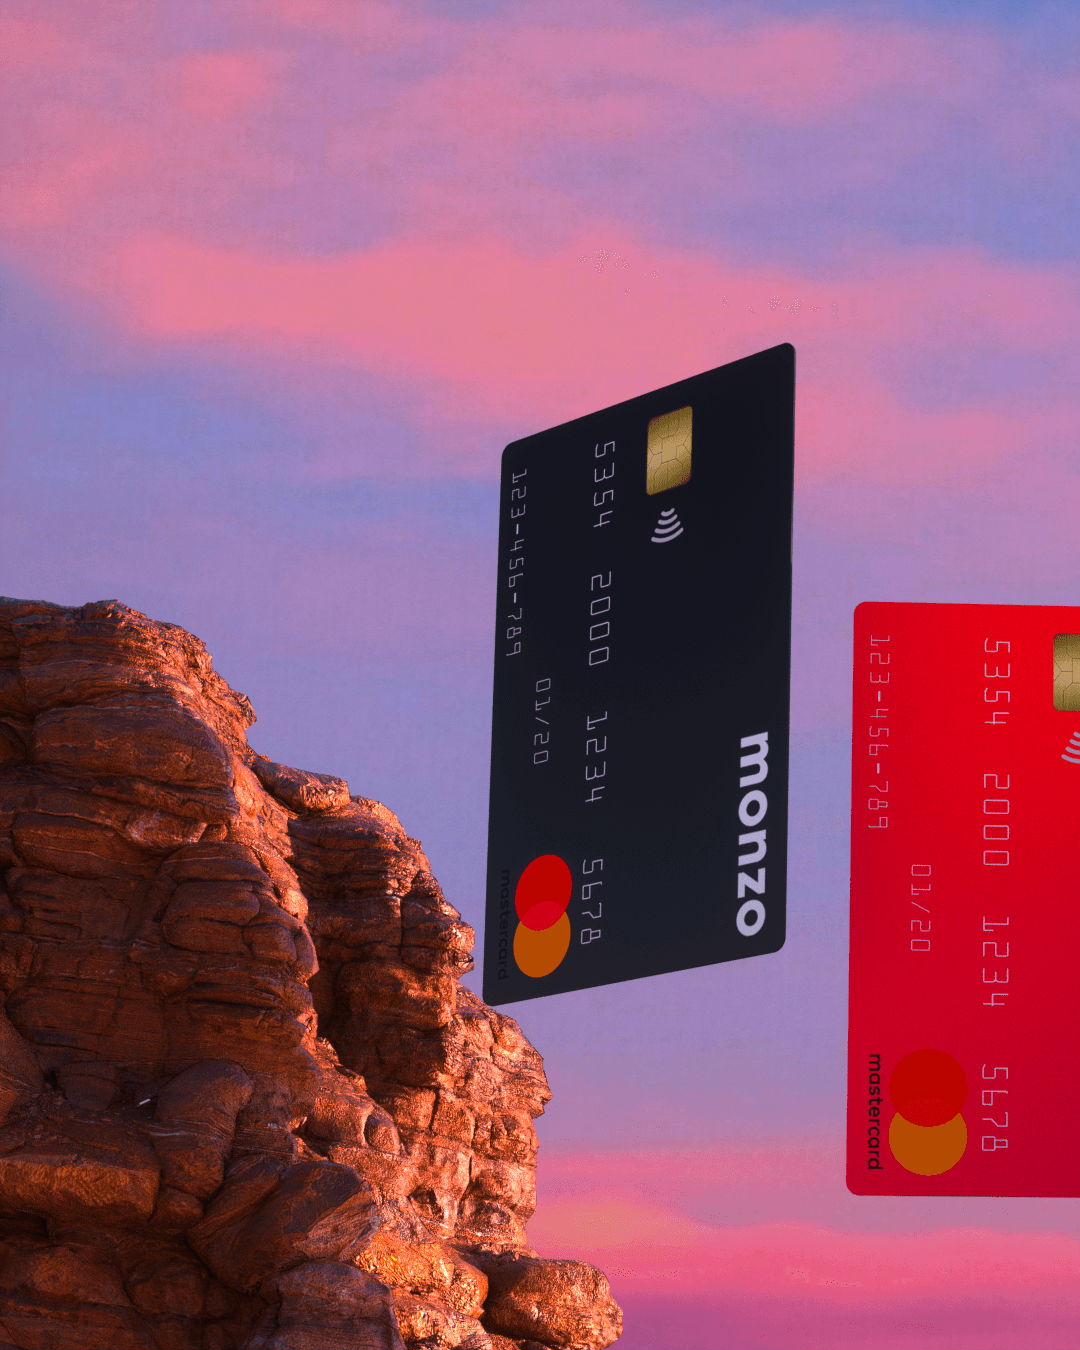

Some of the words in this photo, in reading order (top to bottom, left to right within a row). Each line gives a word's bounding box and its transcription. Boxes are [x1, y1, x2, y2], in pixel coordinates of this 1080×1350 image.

[593, 440, 616, 528] 5354
[505, 469, 528, 657] 123-456-789
[588, 571, 612, 667] 2000
[533, 677, 552, 765] 01/20
[984, 637, 1011, 725] 5354
[584, 711, 608, 803] 1234
[867, 635, 891, 829] 123-456-789
[736, 732, 769, 937] monzo
[983, 773, 1010, 866] 2000
[497, 869, 512, 980] mastercard
[580, 858, 604, 945] 5678
[910, 864, 932, 952] 01/20
[982, 916, 1009, 1007] 1234
[867, 1054, 883, 1170] mastercard
[981, 1064, 1009, 1152] 5678
